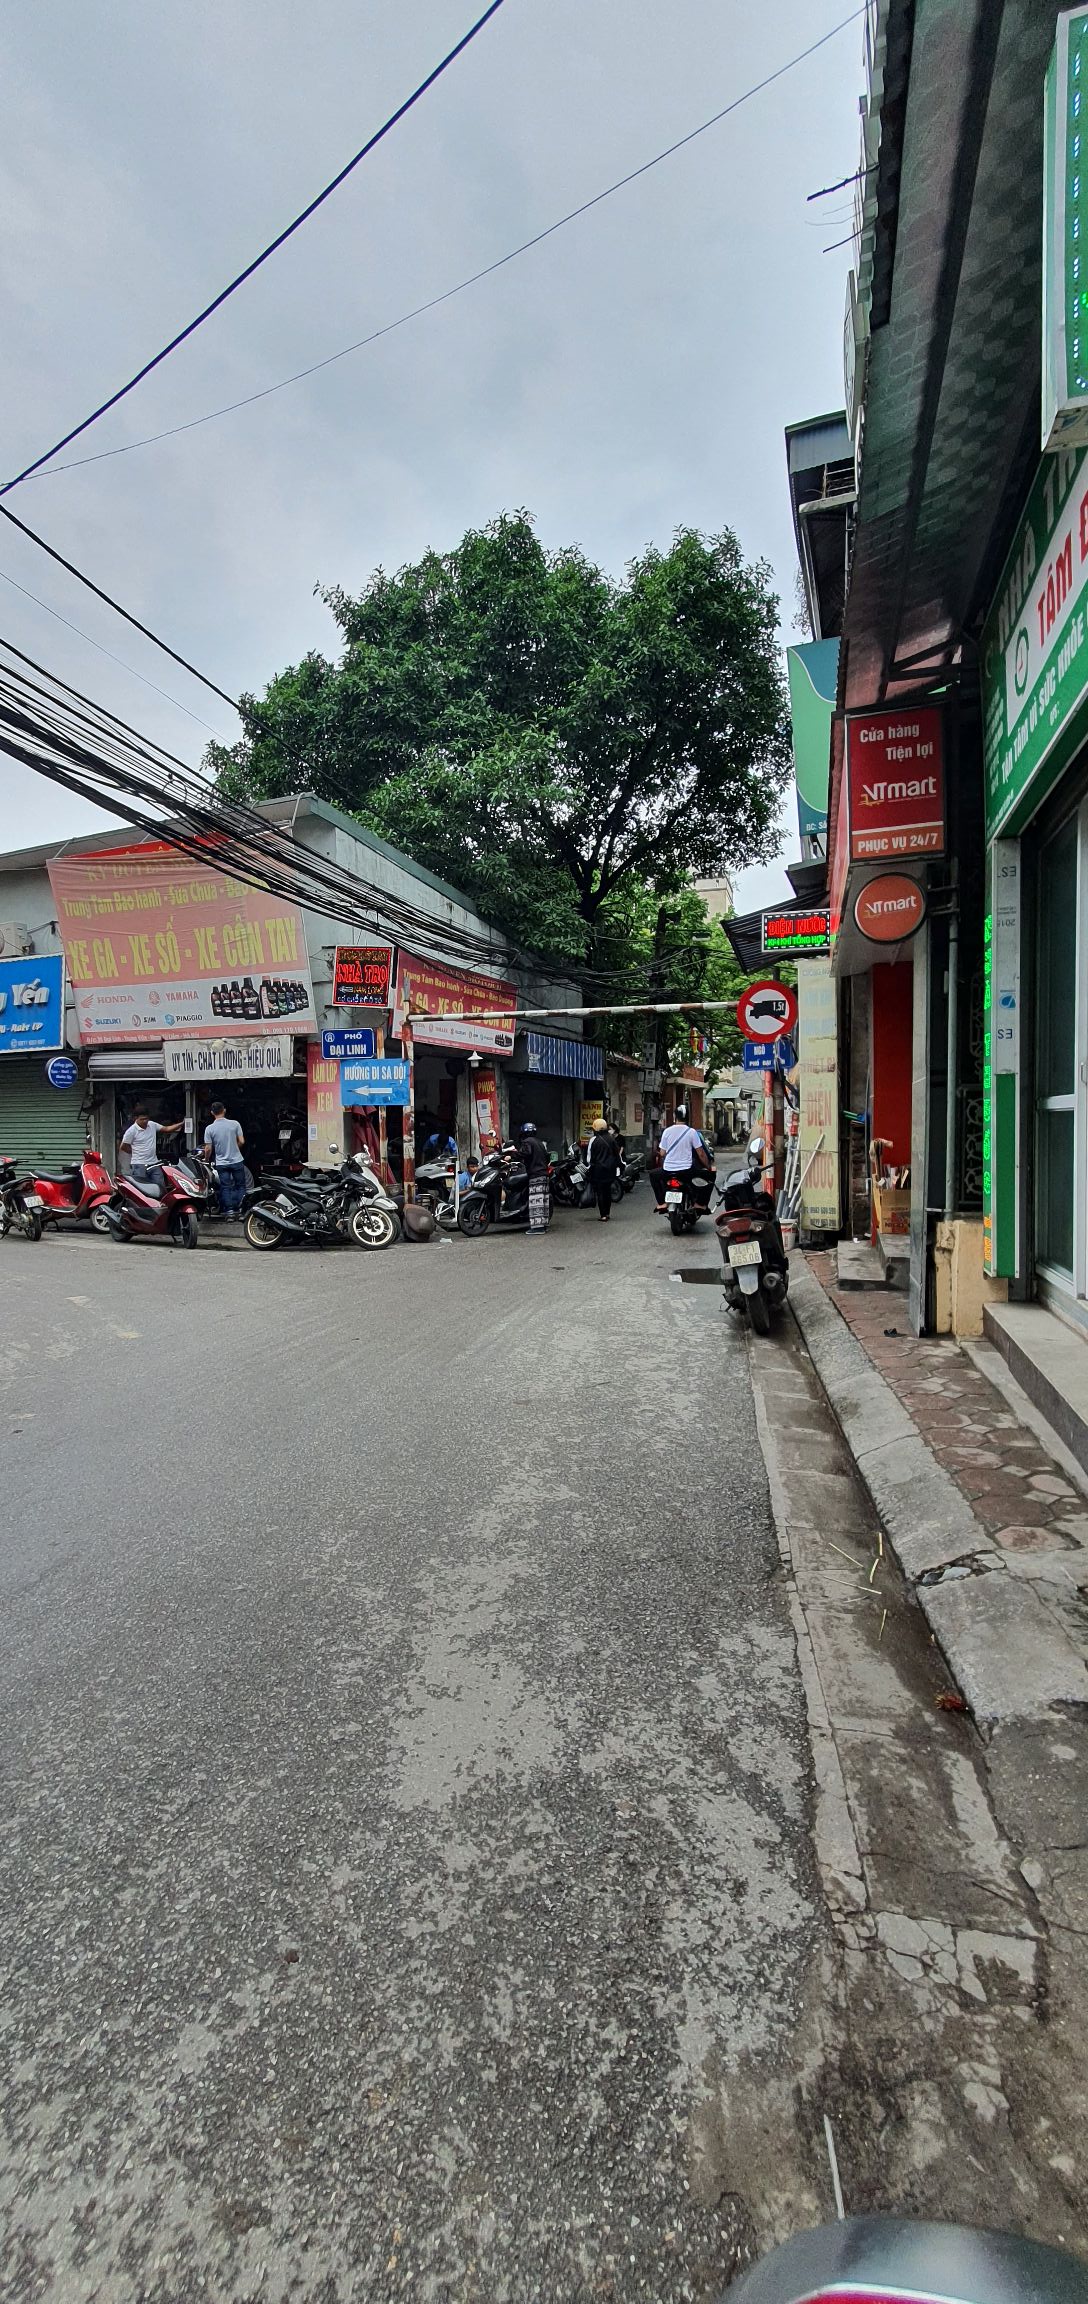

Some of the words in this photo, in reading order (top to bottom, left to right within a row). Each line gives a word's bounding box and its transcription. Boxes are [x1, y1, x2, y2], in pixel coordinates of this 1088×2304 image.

[1038, 528, 1073, 648] TÂM
[860, 726, 885, 743] Cửa
[888, 724, 920, 741] hàng
[886, 746, 914, 762] Tiện
[917, 742, 934, 758] lợi
[858, 839, 889, 855] PHỤC
[892, 837, 907, 851] VỤ
[909, 832, 939, 848] 24/7
[68, 940, 93, 980] XE
[93, 938, 119, 978] GA
[128, 934, 155, 975] XE
[155, 915, 182, 974] SỐ
[193, 927, 221, 970] XE
[222, 914, 265, 967] CÔN
[264, 917, 298, 963] TAY
[11, 978, 50, 1006] Yến
[97, 995, 135, 1004] HONDA
[165, 991, 199, 1001] YAMAHA
[344, 1031, 363, 1039] PHỐ
[172, 1052, 181, 1071] UY
[182, 1049, 194, 1071] TÍN
[330, 1045, 345, 1057] ĐẠI
[347, 1044, 367, 1055] LINH
[344, 1062, 370, 1080] HƯỚNG
[382, 1066, 393, 1080] SA
[316, 1092, 325, 1113] XE
